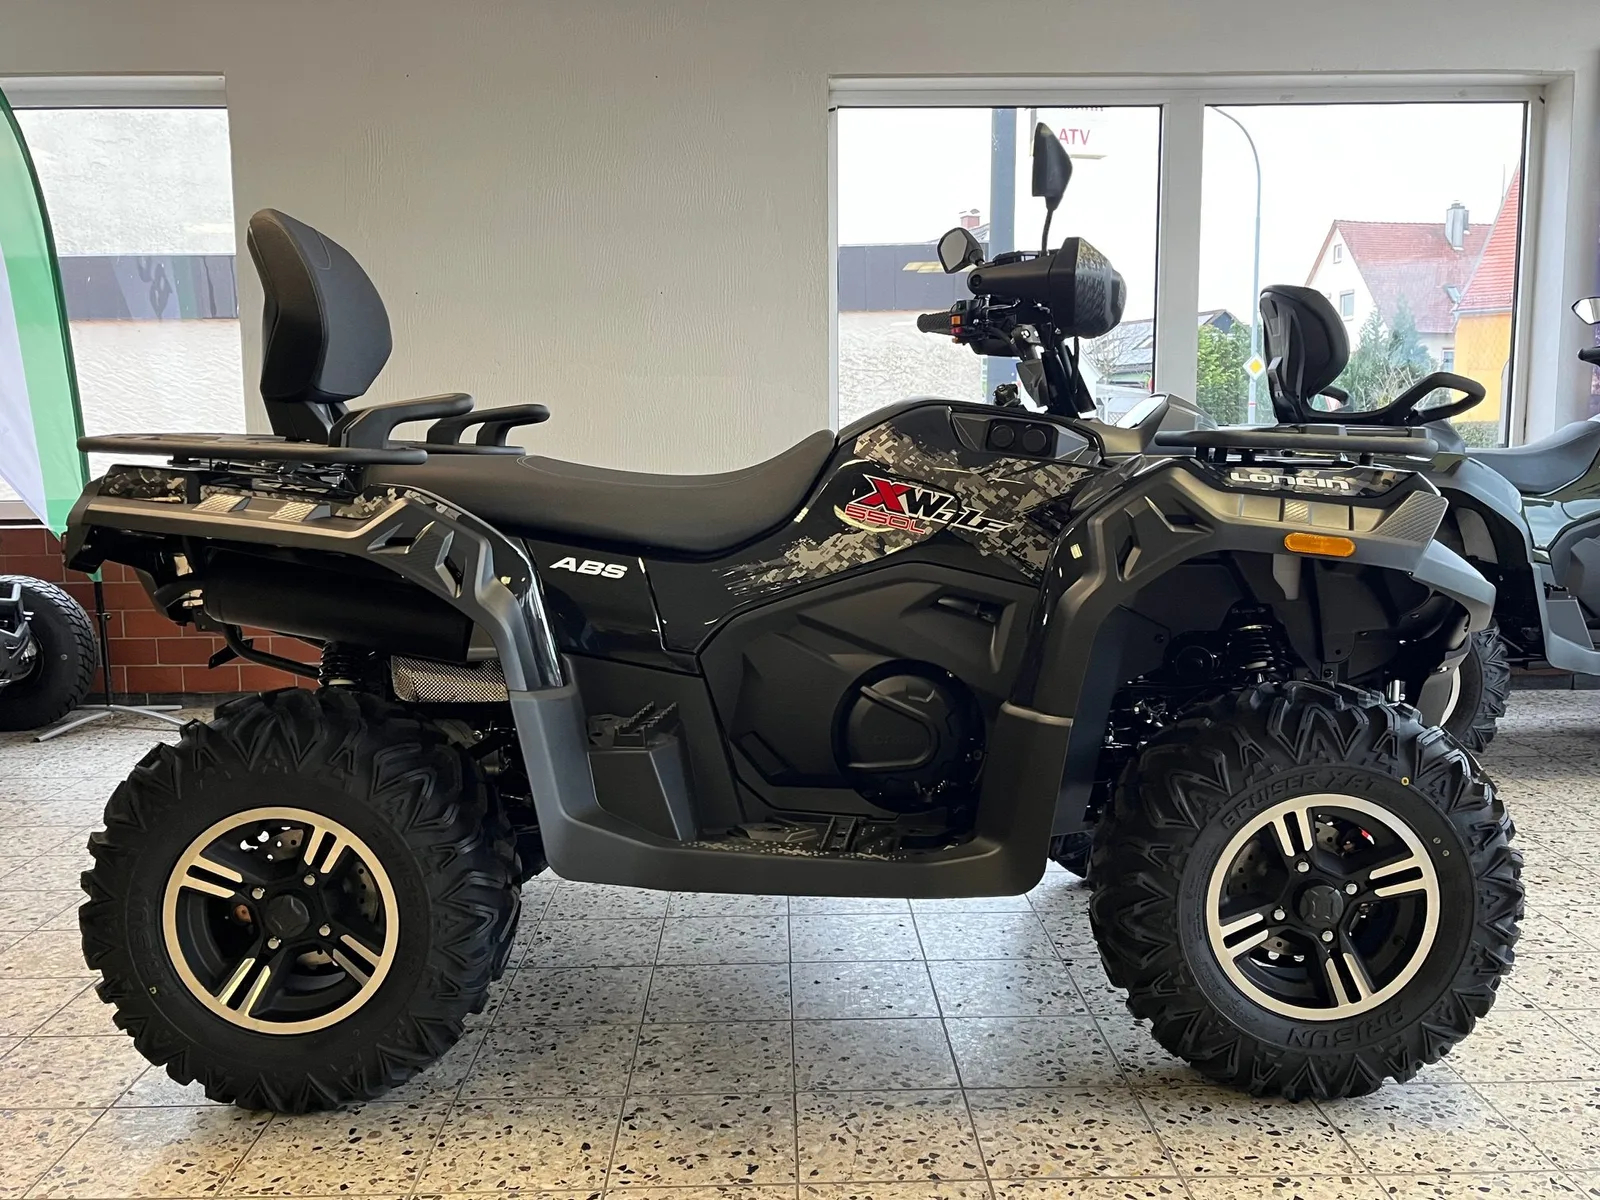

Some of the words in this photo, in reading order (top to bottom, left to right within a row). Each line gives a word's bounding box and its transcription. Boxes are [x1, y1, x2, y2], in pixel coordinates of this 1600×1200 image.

[1058, 128, 1091, 145] ATV
[549, 556, 628, 579] ABS
[1221, 771, 1320, 829] BRUISER
[1287, 1000, 1403, 1049] ARISUN
